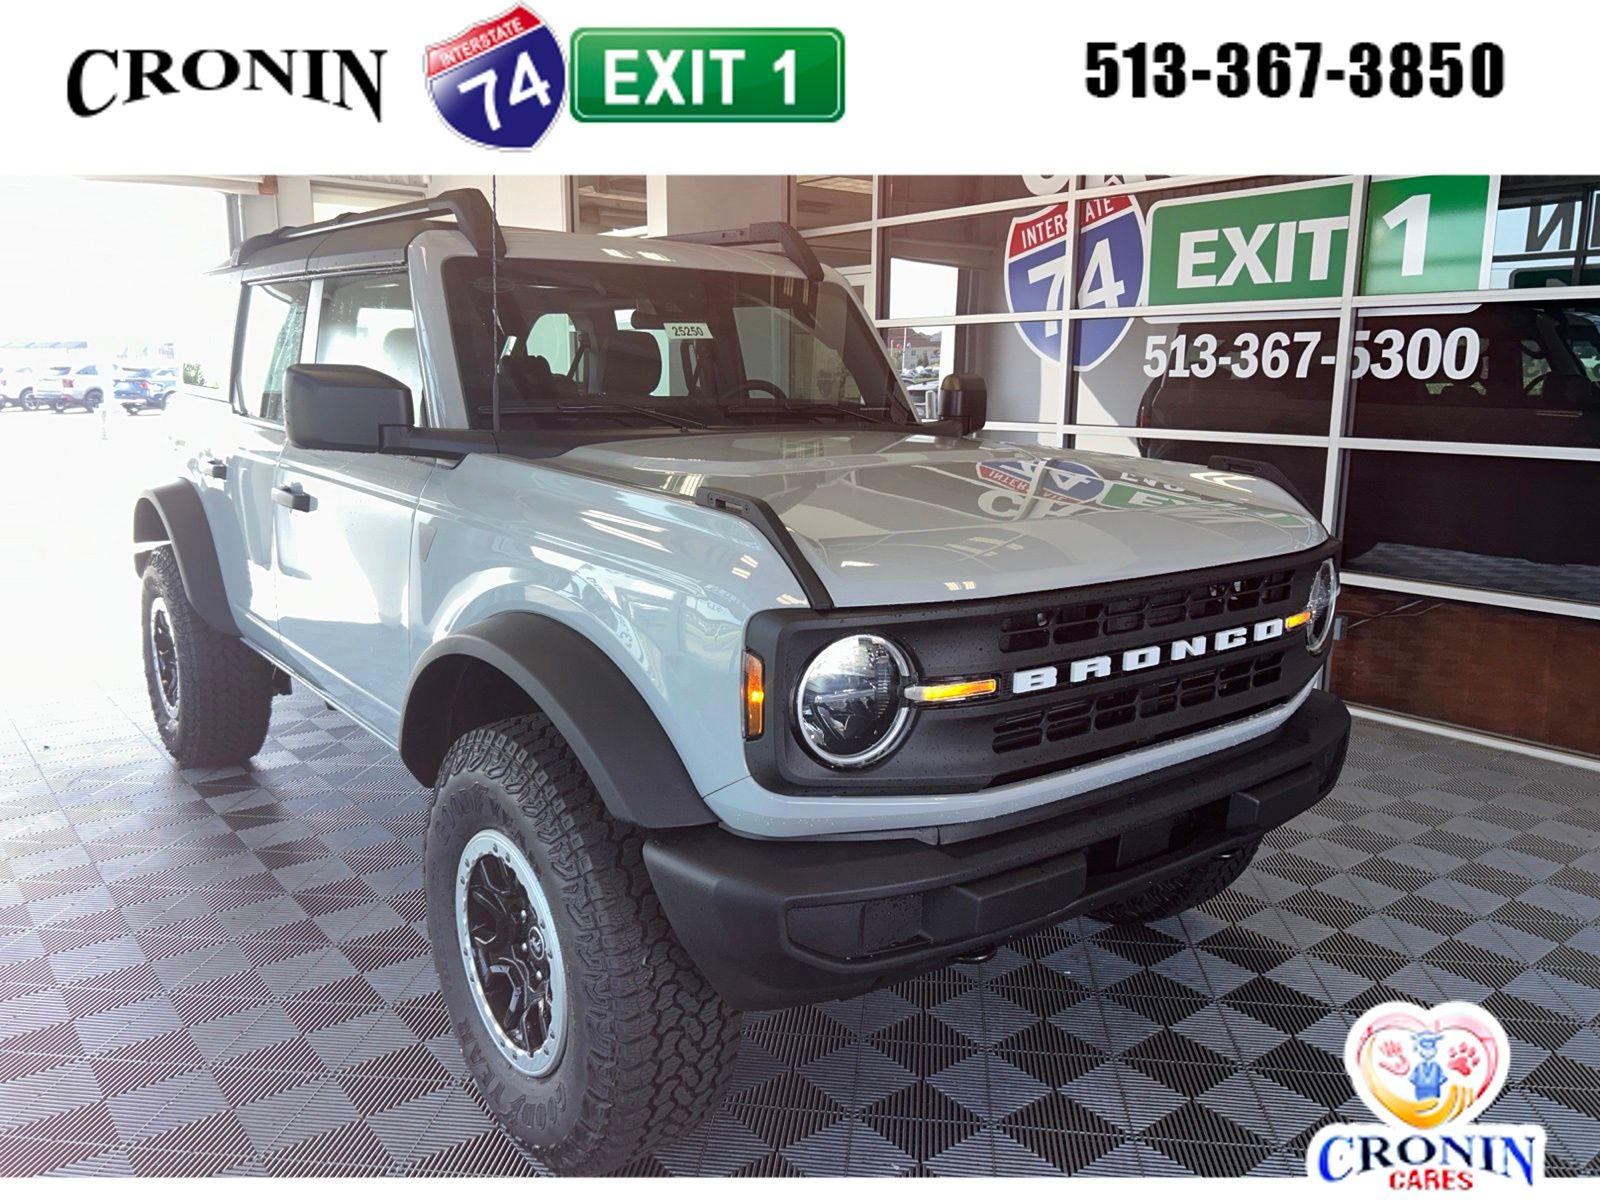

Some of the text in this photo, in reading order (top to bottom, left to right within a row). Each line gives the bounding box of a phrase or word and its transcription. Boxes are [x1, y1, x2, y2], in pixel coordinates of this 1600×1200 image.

[1021, 197, 1115, 249] INTERATE
[1176, 216, 1350, 289] EXIT
[1382, 194, 1431, 277] 1
[1027, 238, 1126, 338] 74
[671, 326, 704, 337] 25250
[1012, 618, 1284, 694] BRONCO
